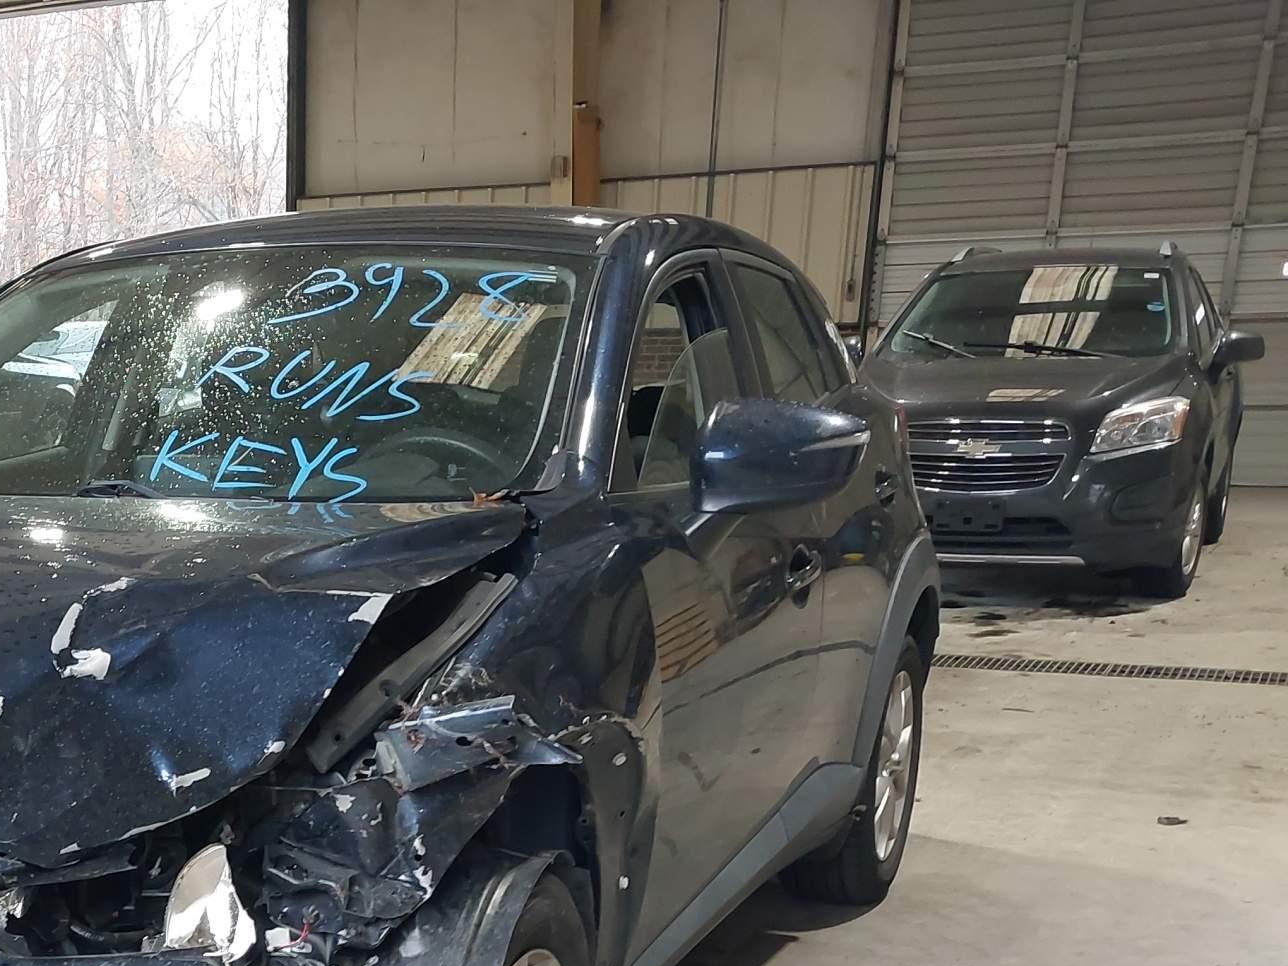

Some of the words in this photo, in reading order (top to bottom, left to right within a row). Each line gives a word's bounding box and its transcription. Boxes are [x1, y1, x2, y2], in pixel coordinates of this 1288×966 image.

[267, 261, 536, 329] 3928
[195, 346, 436, 422] RUNS
[150, 429, 368, 504] KEYS
